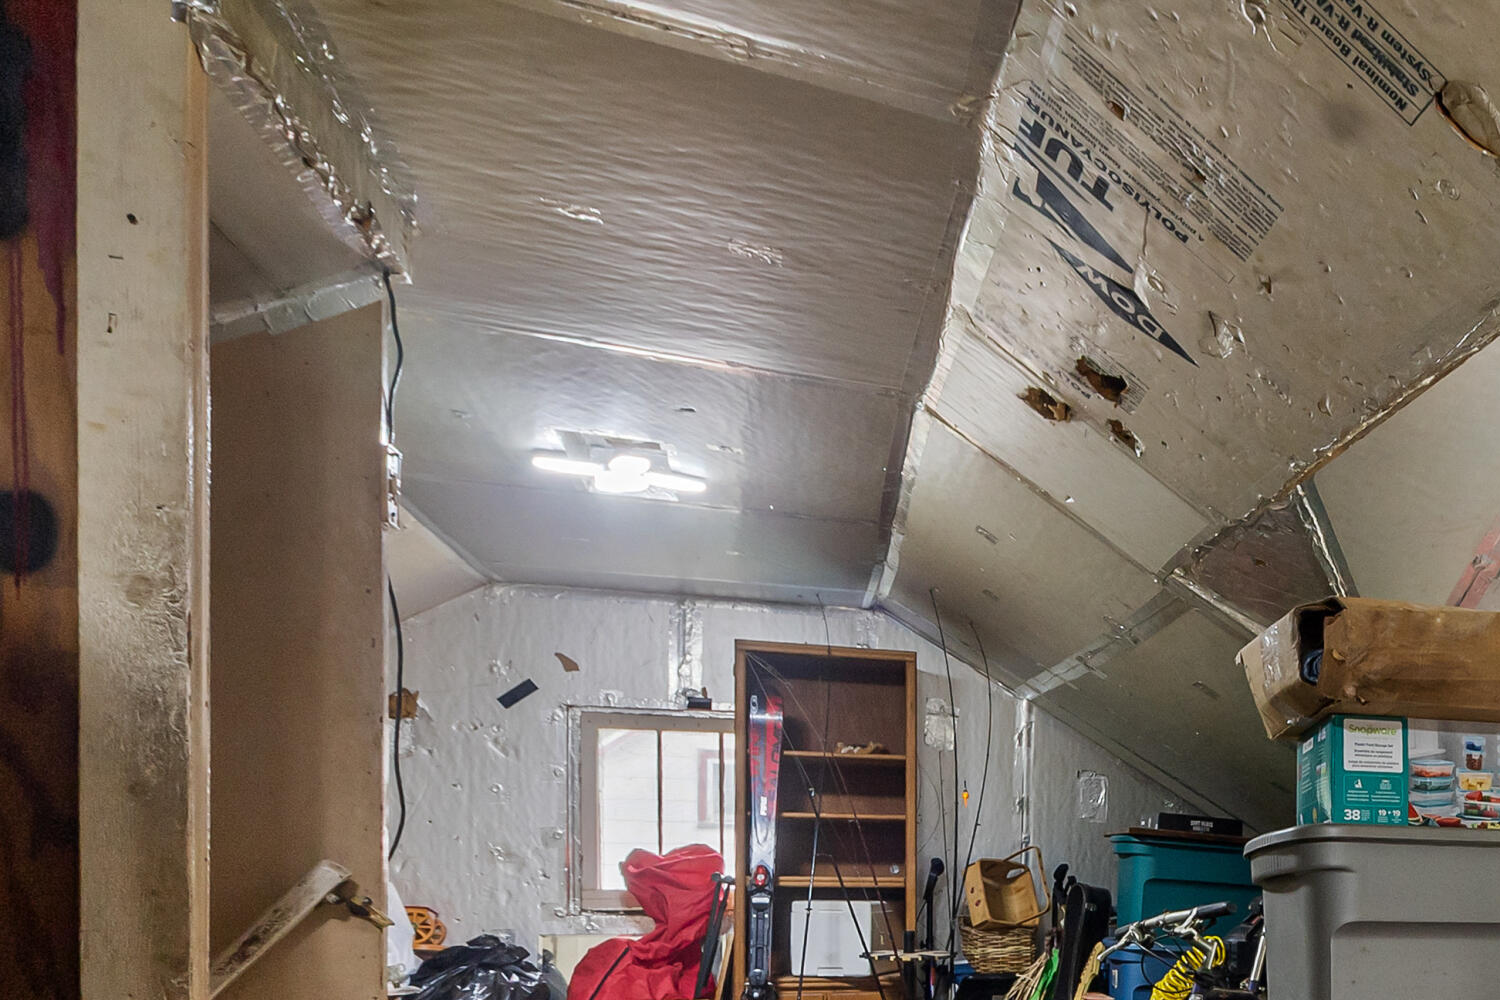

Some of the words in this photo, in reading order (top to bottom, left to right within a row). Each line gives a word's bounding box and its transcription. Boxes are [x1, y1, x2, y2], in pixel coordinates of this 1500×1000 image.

[1310, 15, 1352, 57] Board
[1379, 30, 1430, 82] System
[1353, 55, 1407, 111] Nominal
[1077, 264, 1164, 340] DOW
[1348, 724, 1397, 736] Snapware
[1344, 810, 1360, 820] 38
